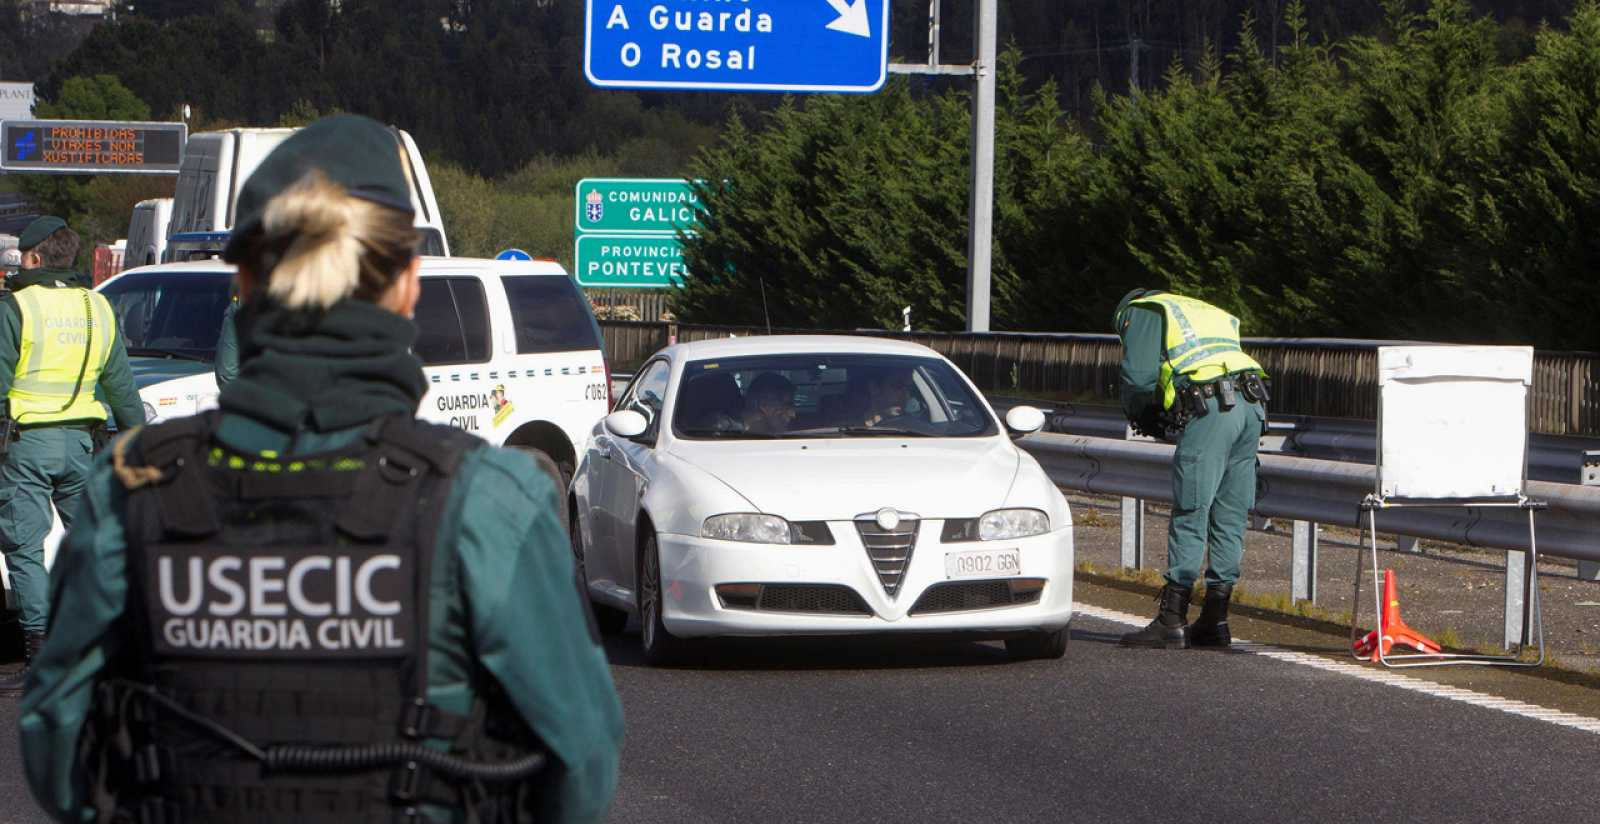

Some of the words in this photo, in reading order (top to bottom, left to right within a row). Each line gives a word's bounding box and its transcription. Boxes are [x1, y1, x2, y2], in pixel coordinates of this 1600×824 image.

[606, 4, 630, 29] A
[649, 5, 772, 32] Guarda
[620, 42, 641, 67] O
[661, 43, 755, 70] Rosal
[51, 127, 137, 140] PROHIBIDAS
[51, 140, 102, 151] VIAXES
[110, 141, 136, 152] NON
[43, 151, 144, 164] XUSTIFICADAS
[629, 207, 711, 222] GALICI
[437, 394, 489, 412] GUARDIA
[450, 416, 480, 431] CIVIL
[158, 555, 402, 617] USECIC
[163, 618, 312, 650] GUARDIA
[316, 617, 405, 649] CIVIL
